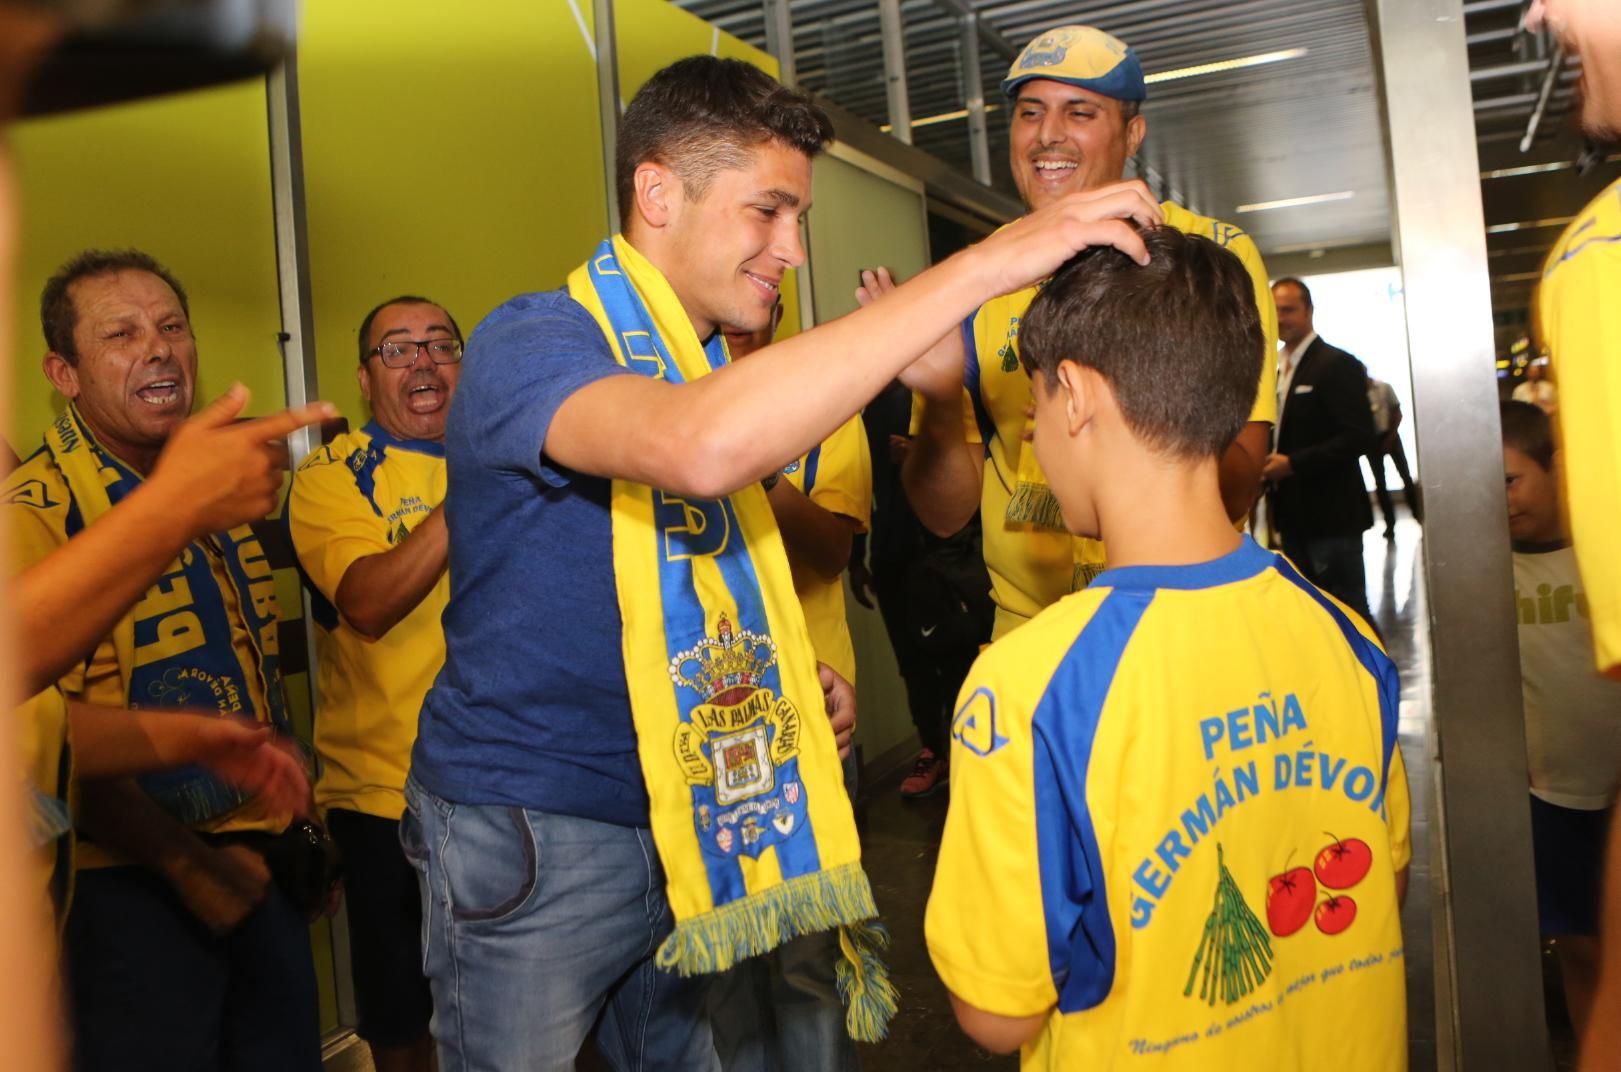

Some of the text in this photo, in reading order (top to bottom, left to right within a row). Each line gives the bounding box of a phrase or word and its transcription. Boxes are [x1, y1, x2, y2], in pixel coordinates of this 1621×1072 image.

[697, 692, 770, 728] LAS PALMAS
[1199, 690, 1308, 760] PEÑA
[1130, 760, 1260, 930] GERMÁN
